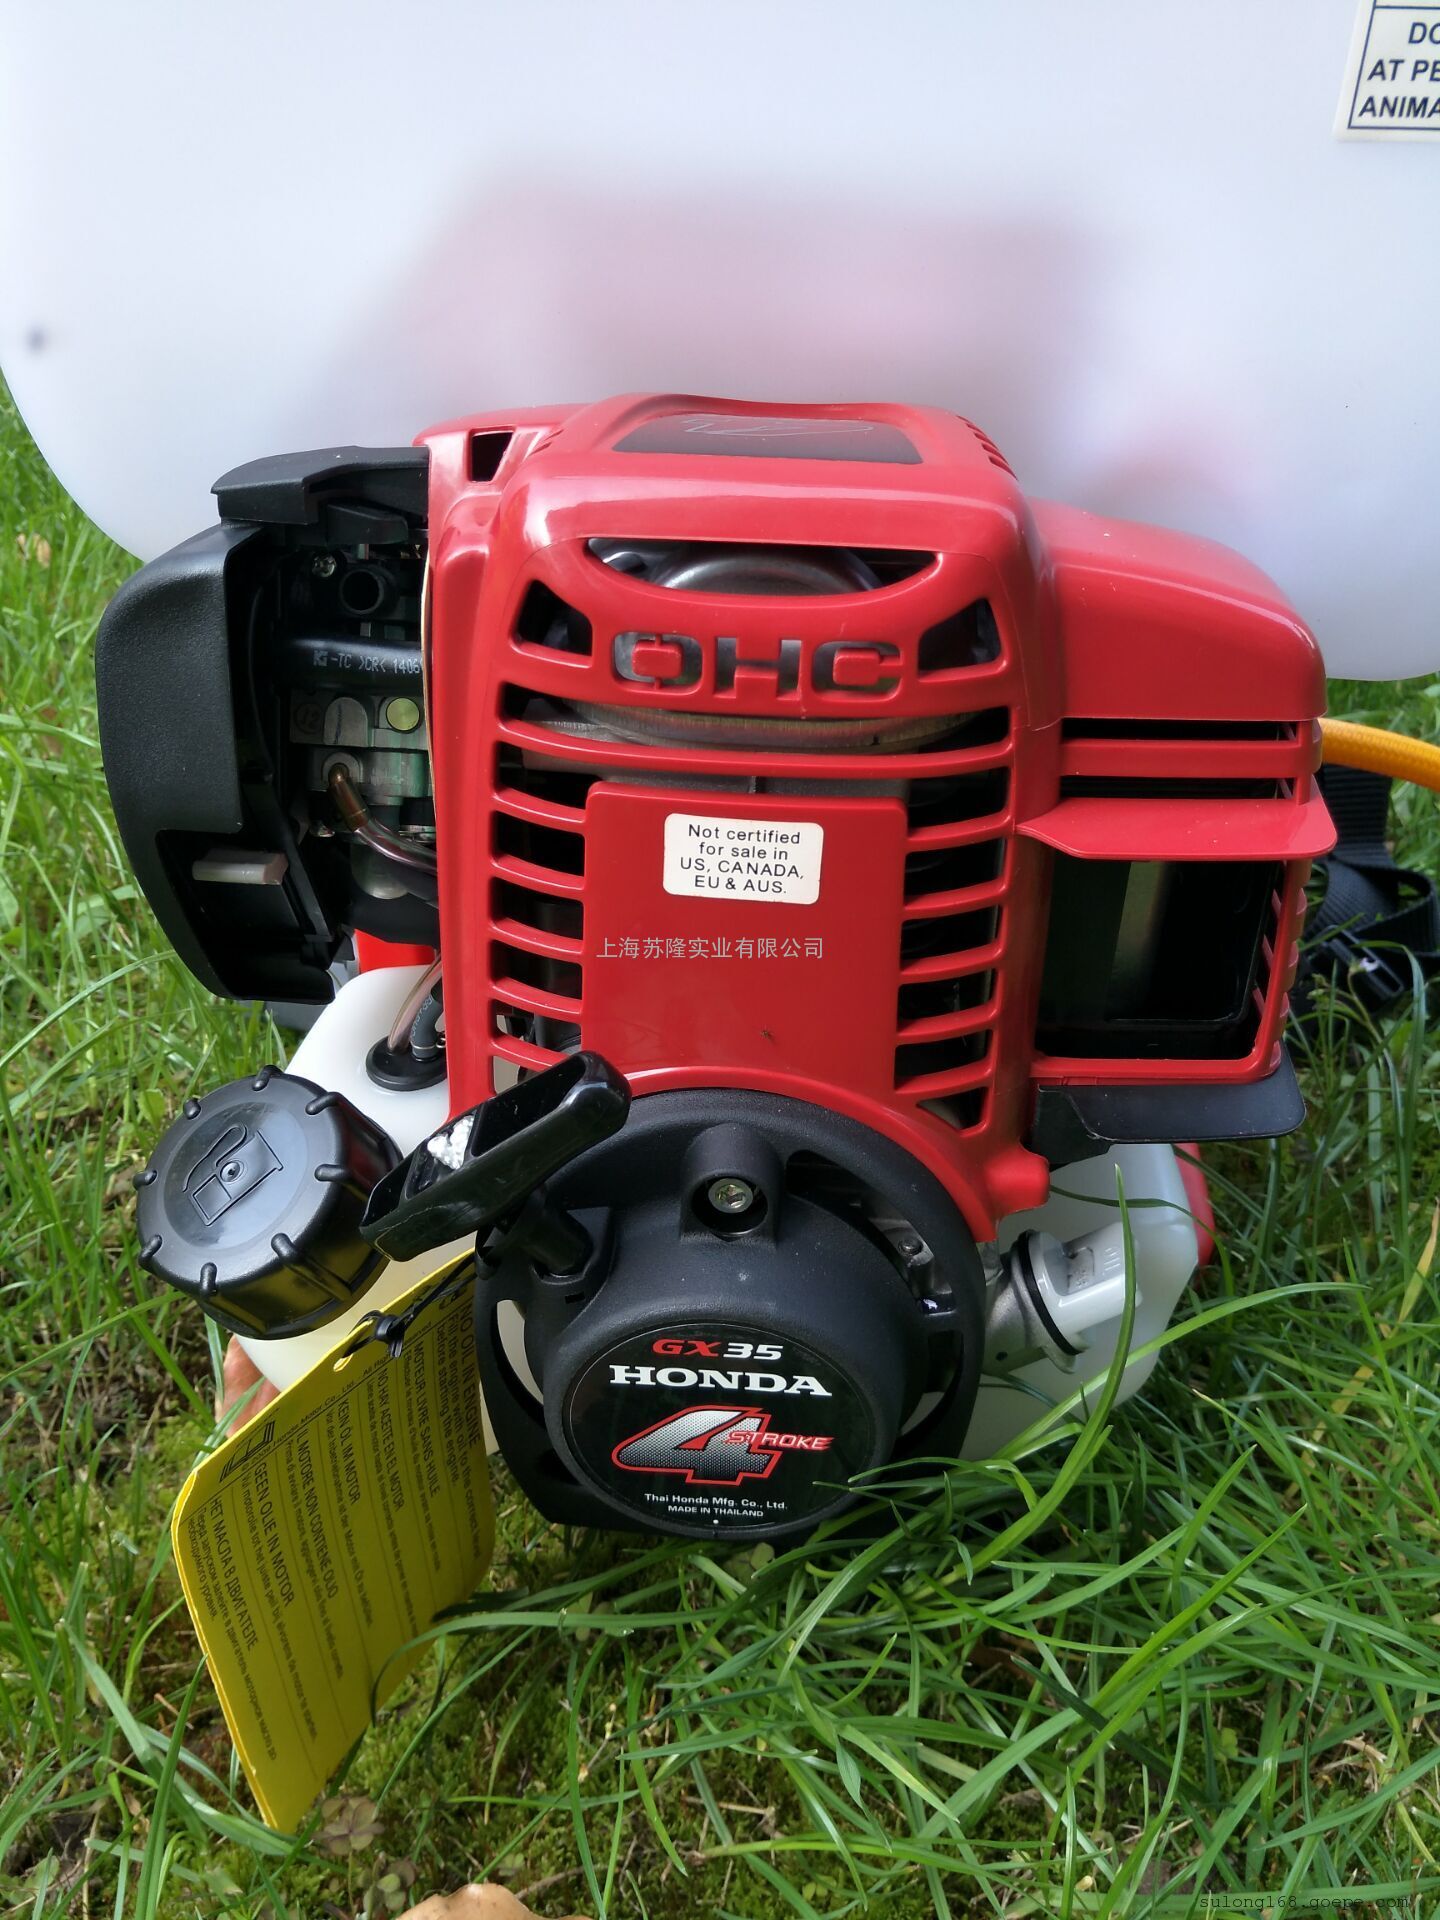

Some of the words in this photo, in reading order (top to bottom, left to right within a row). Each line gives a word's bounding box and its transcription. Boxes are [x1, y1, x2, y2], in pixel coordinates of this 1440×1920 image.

[1367, 58, 1405, 81] AT
[611, 630, 903, 703] OHC
[688, 824, 720, 840] Not
[727, 829, 801, 845] certified
[699, 842, 724, 857] for
[731, 846, 767, 860] sale
[774, 847, 788, 861] in
[680, 857, 711, 873] US,
[718, 860, 805, 879] CANADA,
[694, 875, 720, 889] EU
[725, 877, 737, 890] &
[744, 879, 787, 894] AUS.
[447, 1312, 458, 1335] Fill
[459, 1302, 473, 1334] NO
[436, 1322, 445, 1365] before
[448, 1335, 457, 1359] the
[459, 1332, 473, 1364] OIL
[652, 1338, 721, 1358] GX
[723, 1341, 783, 1361] 35
[377, 1367, 388, 1388] NO
[413, 1340, 426, 1393] MOTEUR
[446, 1359, 460, 1403] engine
[461, 1362, 474, 1384] IN
[608, 1364, 833, 1397] HONDA
[378, 1385, 389, 1408] HAY
[437, 1365, 449, 1417] starting
[338, 1397, 350, 1428] KEIN
[416, 1391, 429, 1427] LIVRE
[452, 1403, 464, 1433] with
[463, 1382, 481, 1448] ENGINE
[296, 1427, 307, 1445] IL
[380, 1406, 393, 1444] ACEITE
[442, 1414, 452, 1439] the
[722, 1429, 835, 1451] STROKE
[342, 1443, 353, 1461] IM
[384, 1440, 395, 1460] EN
[419, 1424, 434, 1462] SANS
[456, 1432, 466, 1451] oil
[298, 1439, 314, 1489] MOTORE
[386, 1456, 397, 1473] EL
[444, 1438, 460, 1487] engine.
[458, 1450, 468, 1467] to
[253, 1461, 269, 1502] GEEN
[344, 1459, 361, 1505] MOTOR
[389, 1470, 404, 1512] MOTOR
[426, 1458, 440, 1497] HUILE
[461, 1464, 472, 1490] the
[209, 1495, 223, 1522] НЕТ
[304, 1486, 319, 1516] NON
[644, 1493, 669, 1503] Thai
[672, 1494, 710, 1505] Honda
[712, 1496, 738, 1508] Mfg.
[741, 1498, 763, 1509] Co.,
[766, 1501, 788, 1510] Ltd.
[668, 1505, 698, 1514] MADE
[700, 1507, 711, 1515] IN
[713, 1507, 764, 1517] THAILAND
[259, 1499, 276, 1536] OLIE
[212, 1518, 233, 1569] МАСЛА
[267, 1533, 280, 1553] IN
[310, 1513, 331, 1572] CONTIENE
[223, 1564, 236, 1580] В
[270, 1550, 295, 1607] MOTOR
[322, 1567, 338, 1599] OLIO
[224, 1575, 259, 1652] ДВИГАТЕЛЕ
